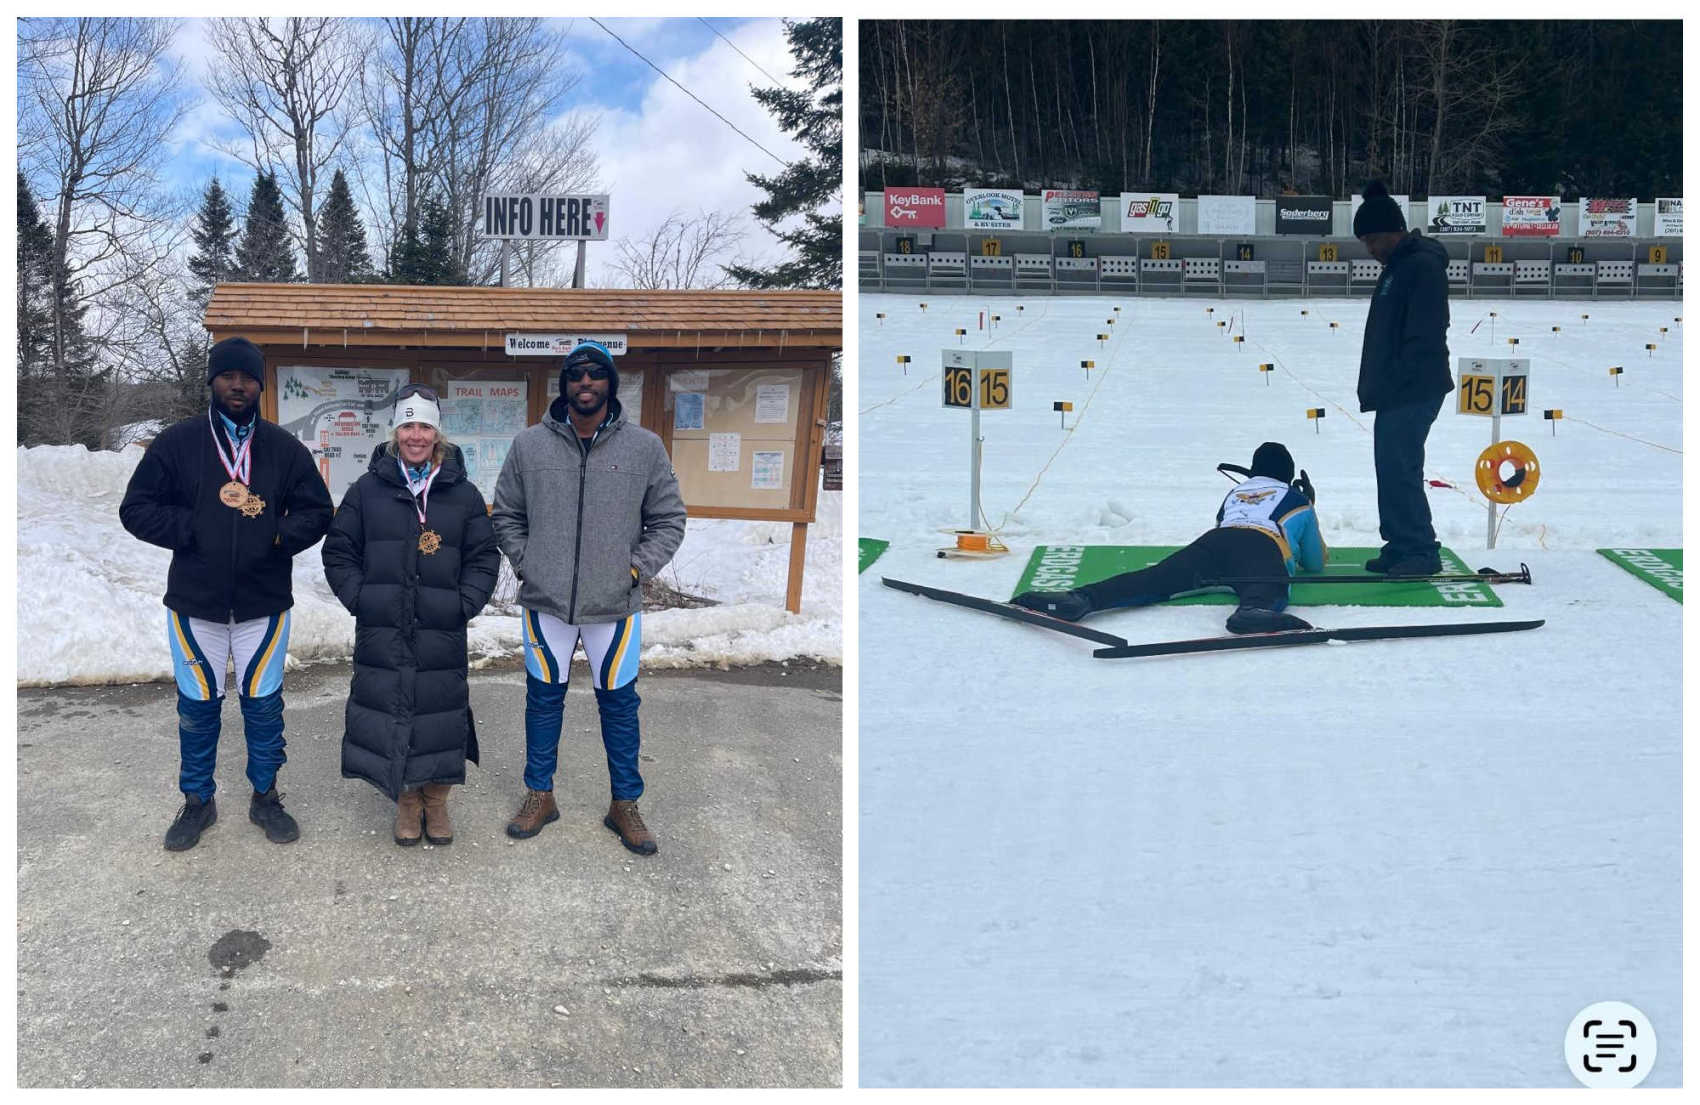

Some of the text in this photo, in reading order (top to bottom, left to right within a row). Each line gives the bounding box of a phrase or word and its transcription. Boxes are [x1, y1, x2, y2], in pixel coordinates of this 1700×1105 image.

[889, 194, 941, 206] KeyBank
[1505, 199, 1543, 208] Gene's
[1453, 202, 1481, 212] TNT
[486, 197, 592, 236] INFO HERE
[1280, 208, 1330, 220] Soderberg
[899, 240, 911, 253] 18
[986, 243, 998, 256] 17
[1072, 244, 1082, 258] 16
[1154, 245, 1167, 260] 15
[1240, 247, 1250, 260] 14
[1323, 248, 1334, 261] 13
[1488, 249, 1498, 262] 11
[1572, 250, 1582, 263] 10
[1655, 250, 1662, 262] 9
[509, 338, 550, 349] Welcome
[456, 387, 520, 397] TRAIL MAPS
[946, 369, 971, 404] 16
[980, 371, 1009, 405] 15
[1462, 377, 1493, 411] 15
[1503, 377, 1525, 412] 14
